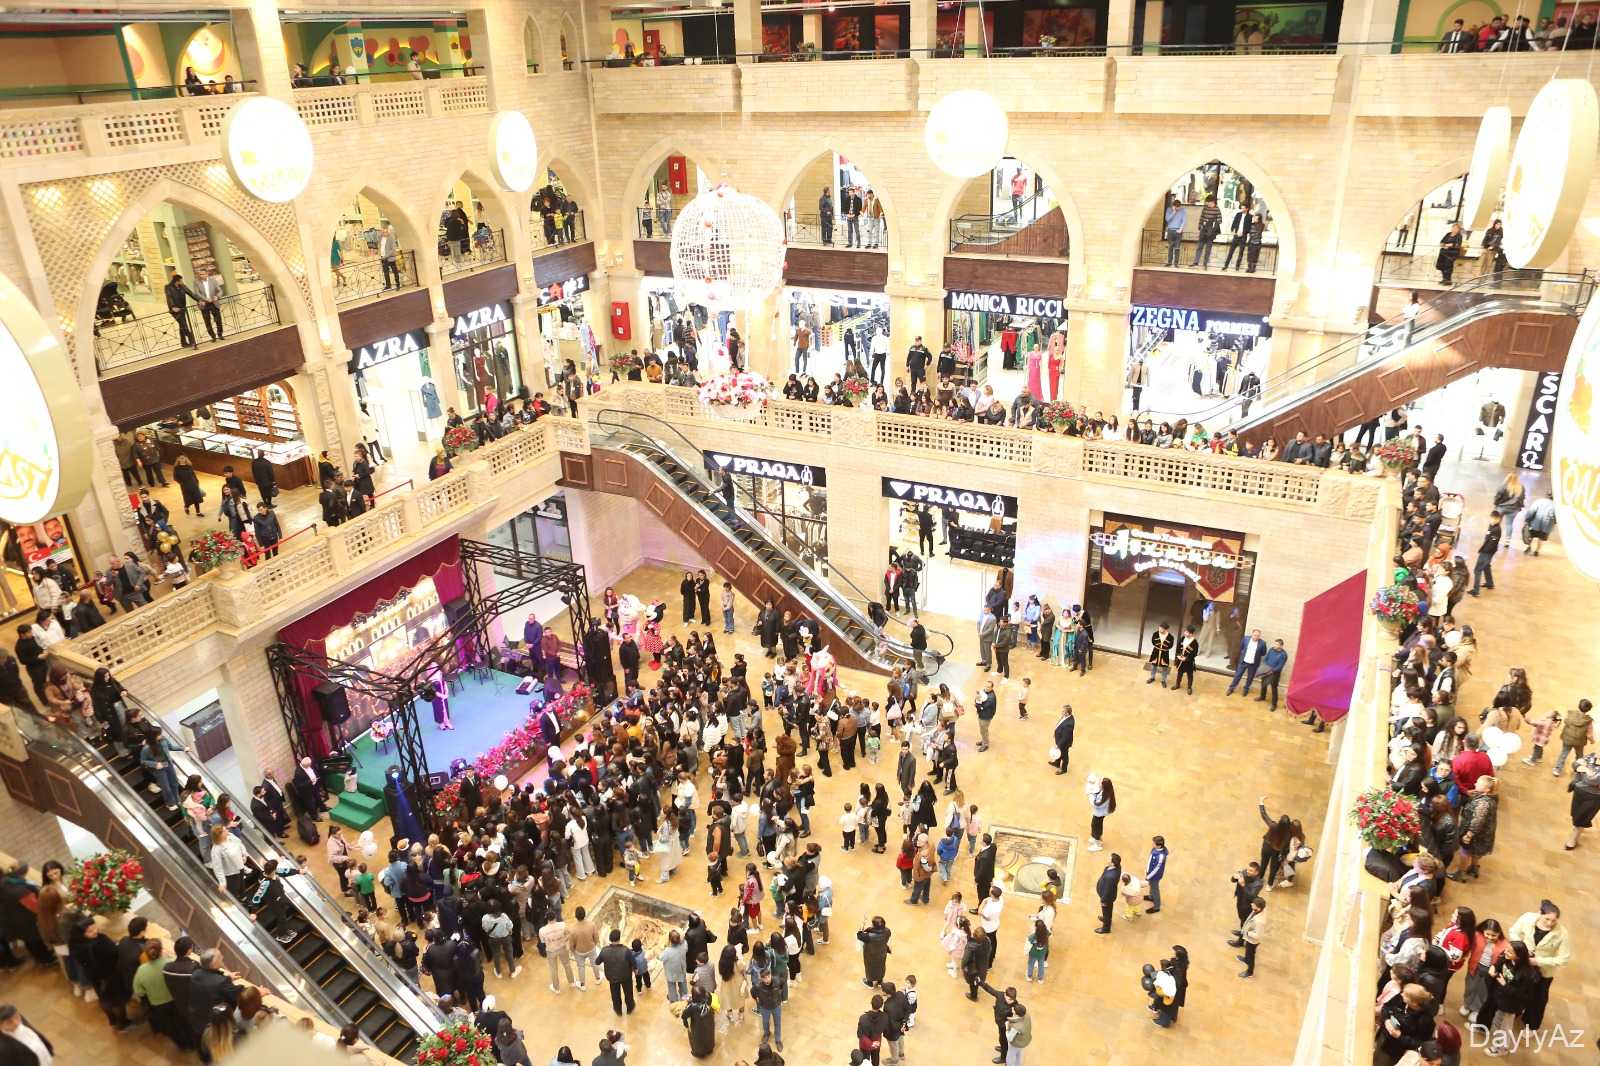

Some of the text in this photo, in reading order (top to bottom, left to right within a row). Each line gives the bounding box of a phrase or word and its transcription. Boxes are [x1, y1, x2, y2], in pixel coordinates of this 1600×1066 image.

[952, 292, 1062, 317] MONICA RICCI
[455, 303, 506, 336] AZRA
[1132, 306, 1200, 331] ZEGNA
[357, 333, 419, 369] AZRA
[734, 457, 800, 481] PRAQA
[914, 483, 990, 512] PRAQA
